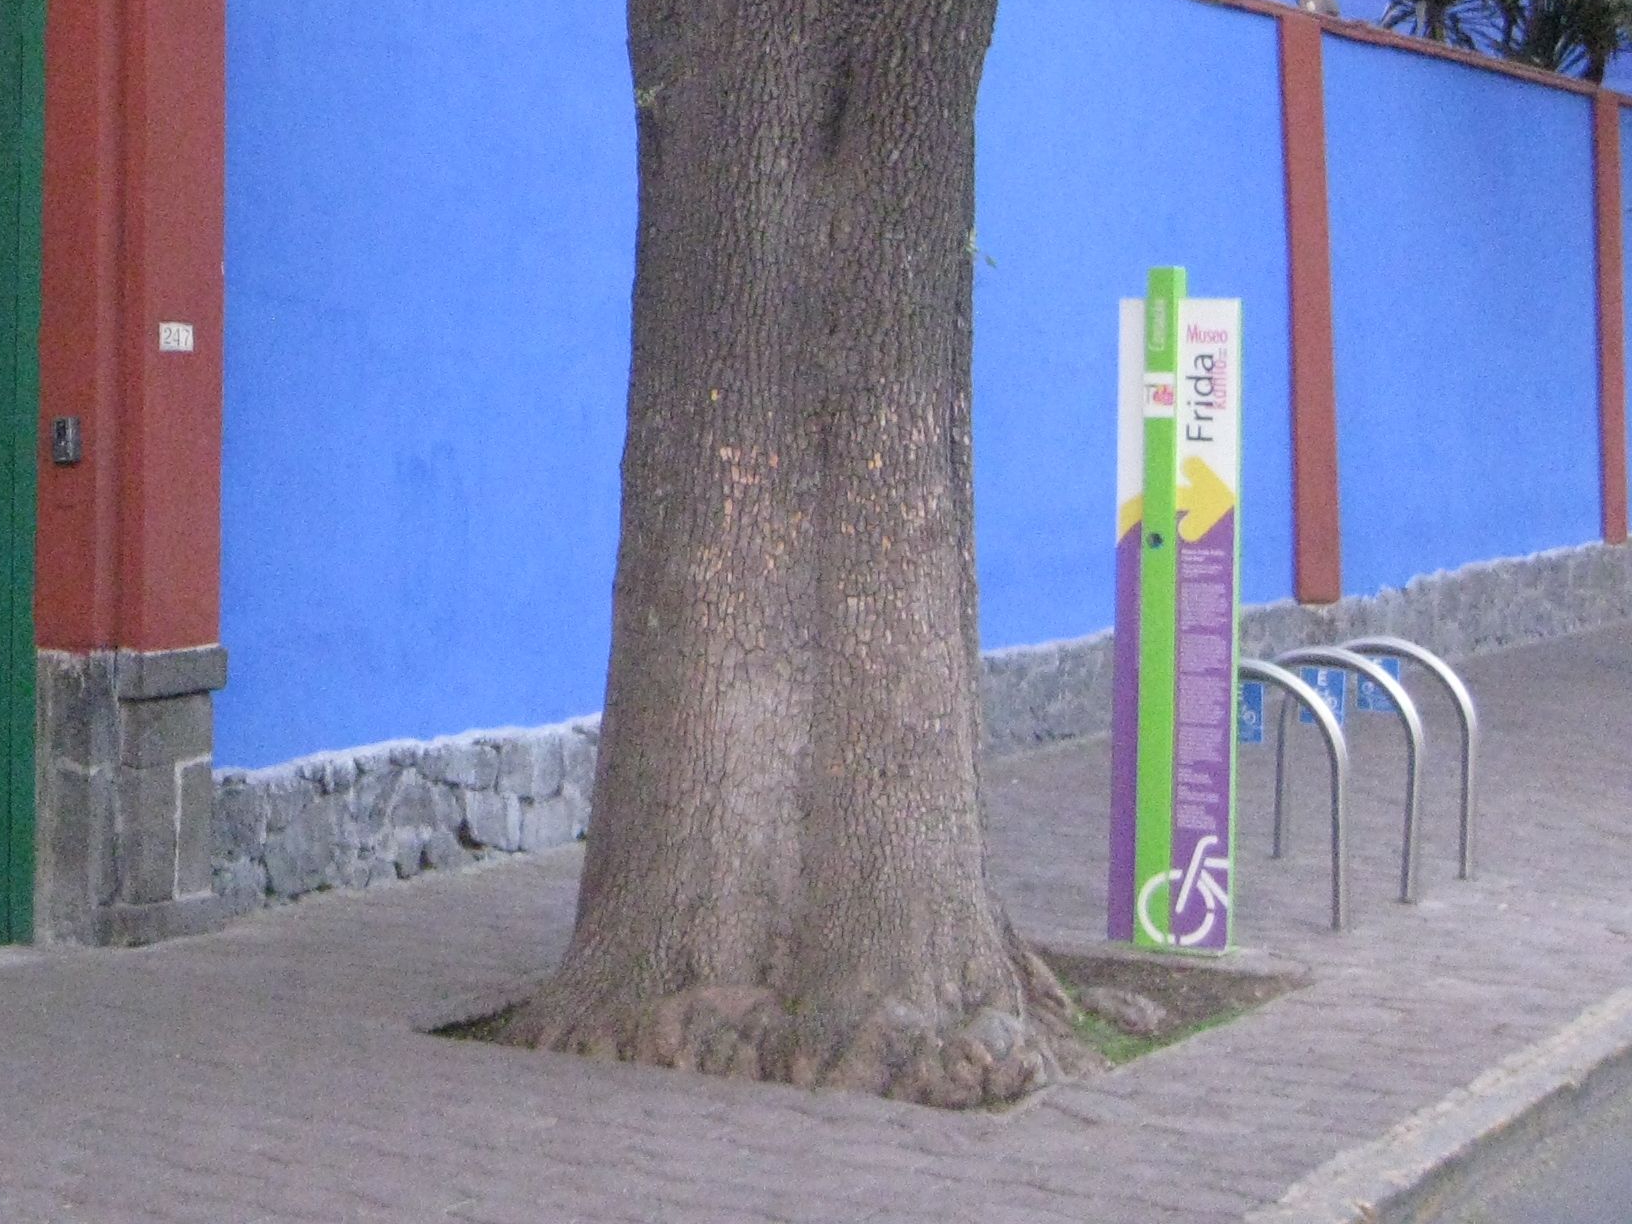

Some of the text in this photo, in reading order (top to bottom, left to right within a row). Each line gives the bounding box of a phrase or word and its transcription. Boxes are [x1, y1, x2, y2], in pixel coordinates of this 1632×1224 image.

[163, 327, 191, 346] 247
[1186, 324, 1228, 344] Museo
[1185, 354, 1215, 443] Frida
